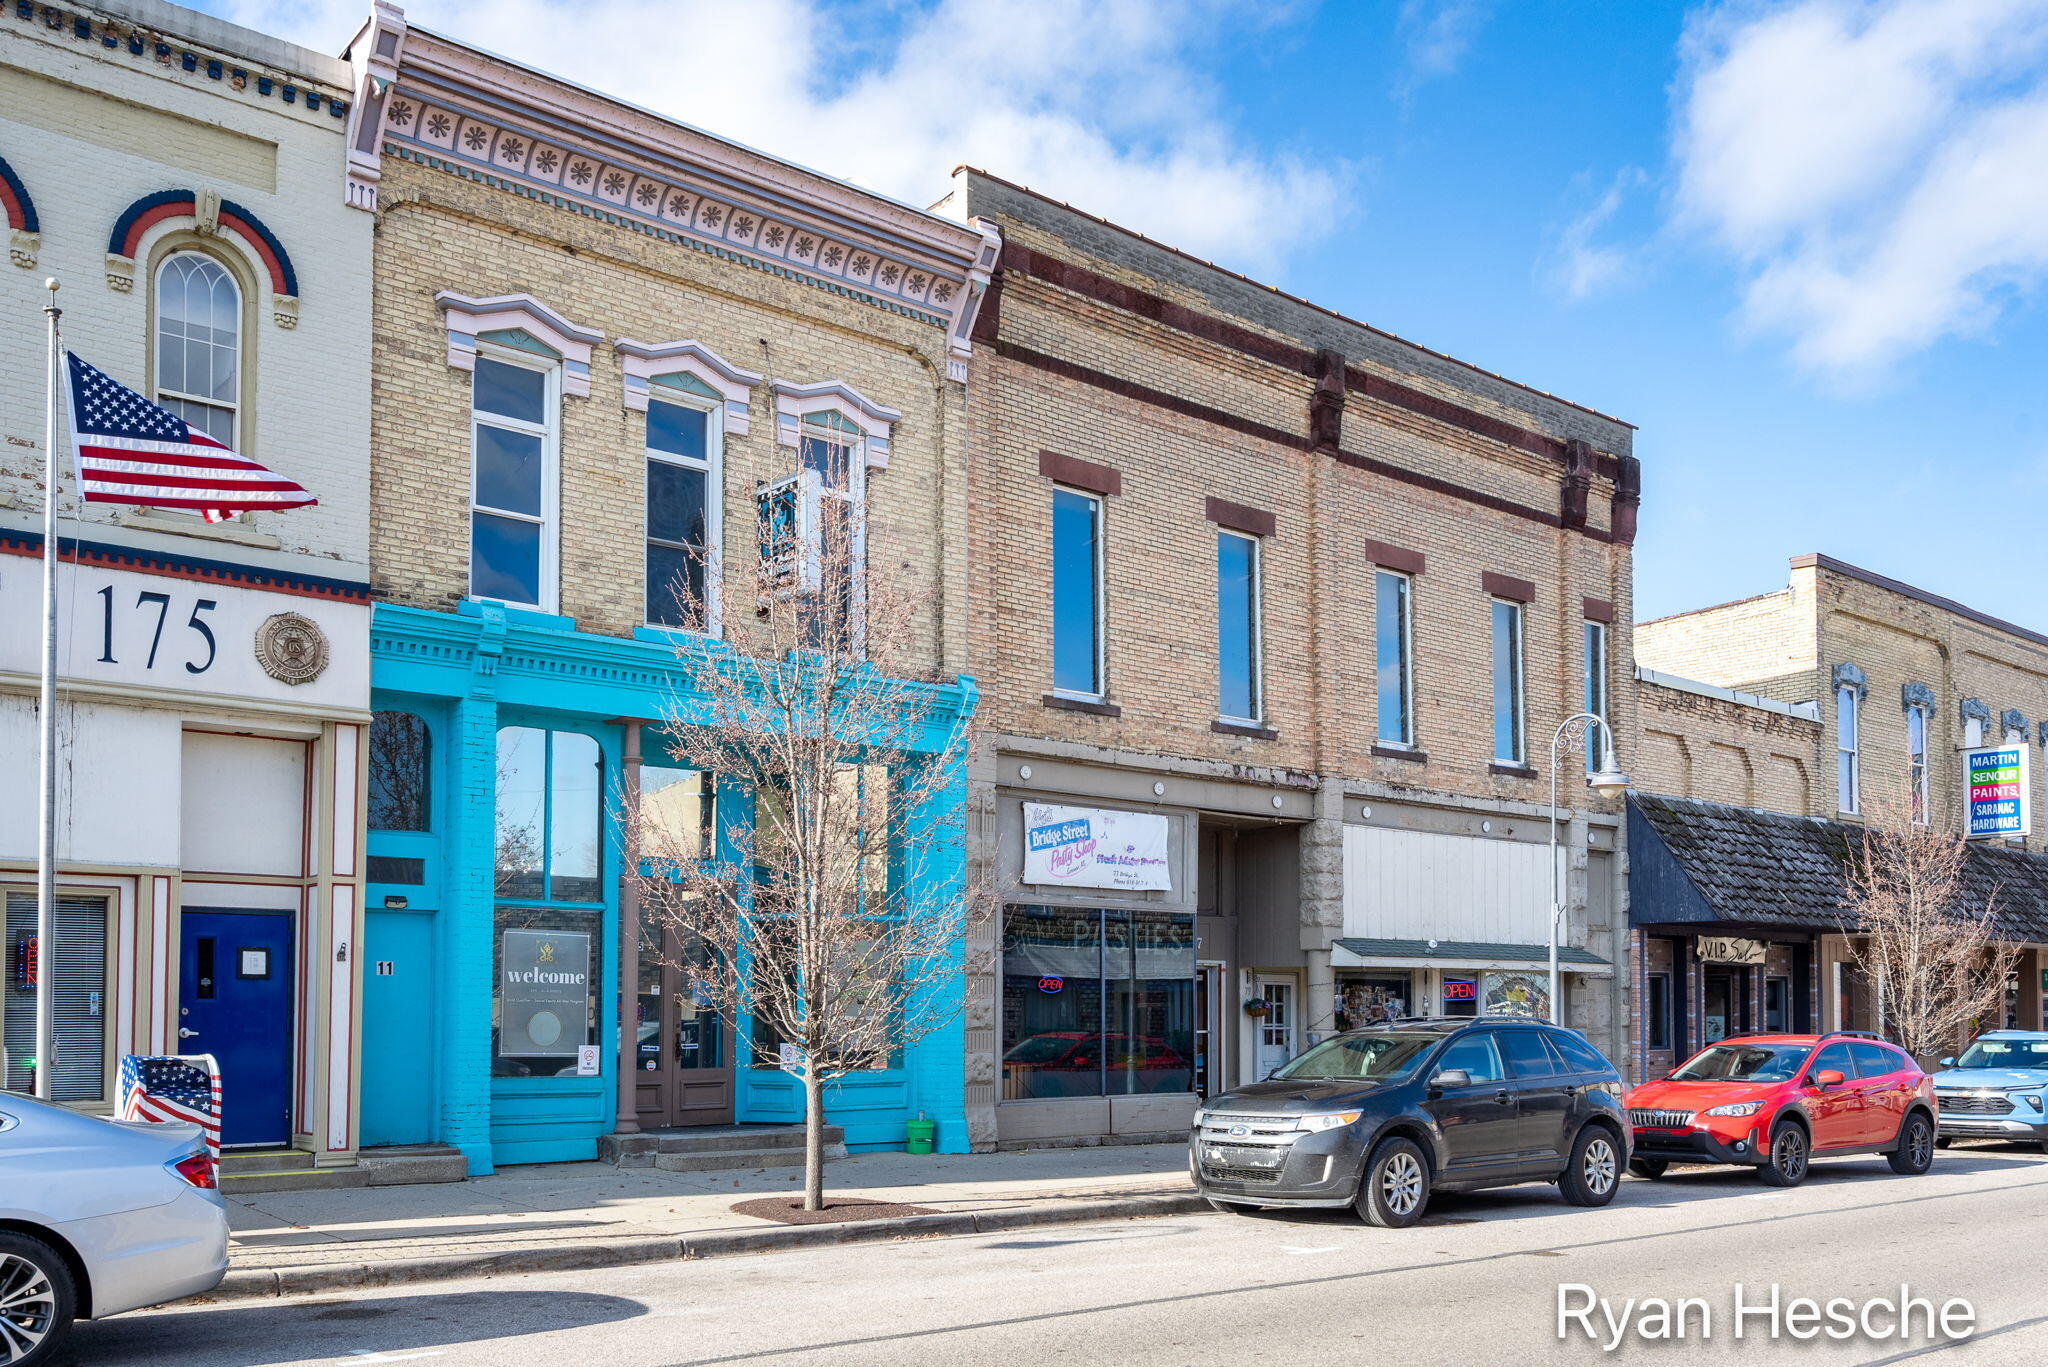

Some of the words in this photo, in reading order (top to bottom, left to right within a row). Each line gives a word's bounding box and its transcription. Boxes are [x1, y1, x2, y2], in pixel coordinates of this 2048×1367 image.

[97, 585, 217, 674] 175
[1972, 753, 2017, 767] MARTIN
[1973, 769, 2017, 783] SENOUR
[1973, 785, 2018, 798] PAINTS
[1976, 801, 2015, 816] SARANAC
[1972, 816, 2019, 830] HARDWARE
[1032, 828, 1061, 847] Bridge
[1062, 823, 1088, 840] Street
[378, 961, 392, 975] 11
[508, 966, 585, 985] welcome
[1038, 978, 1063, 990] OPEN
[1443, 983, 1474, 998] OPEN
